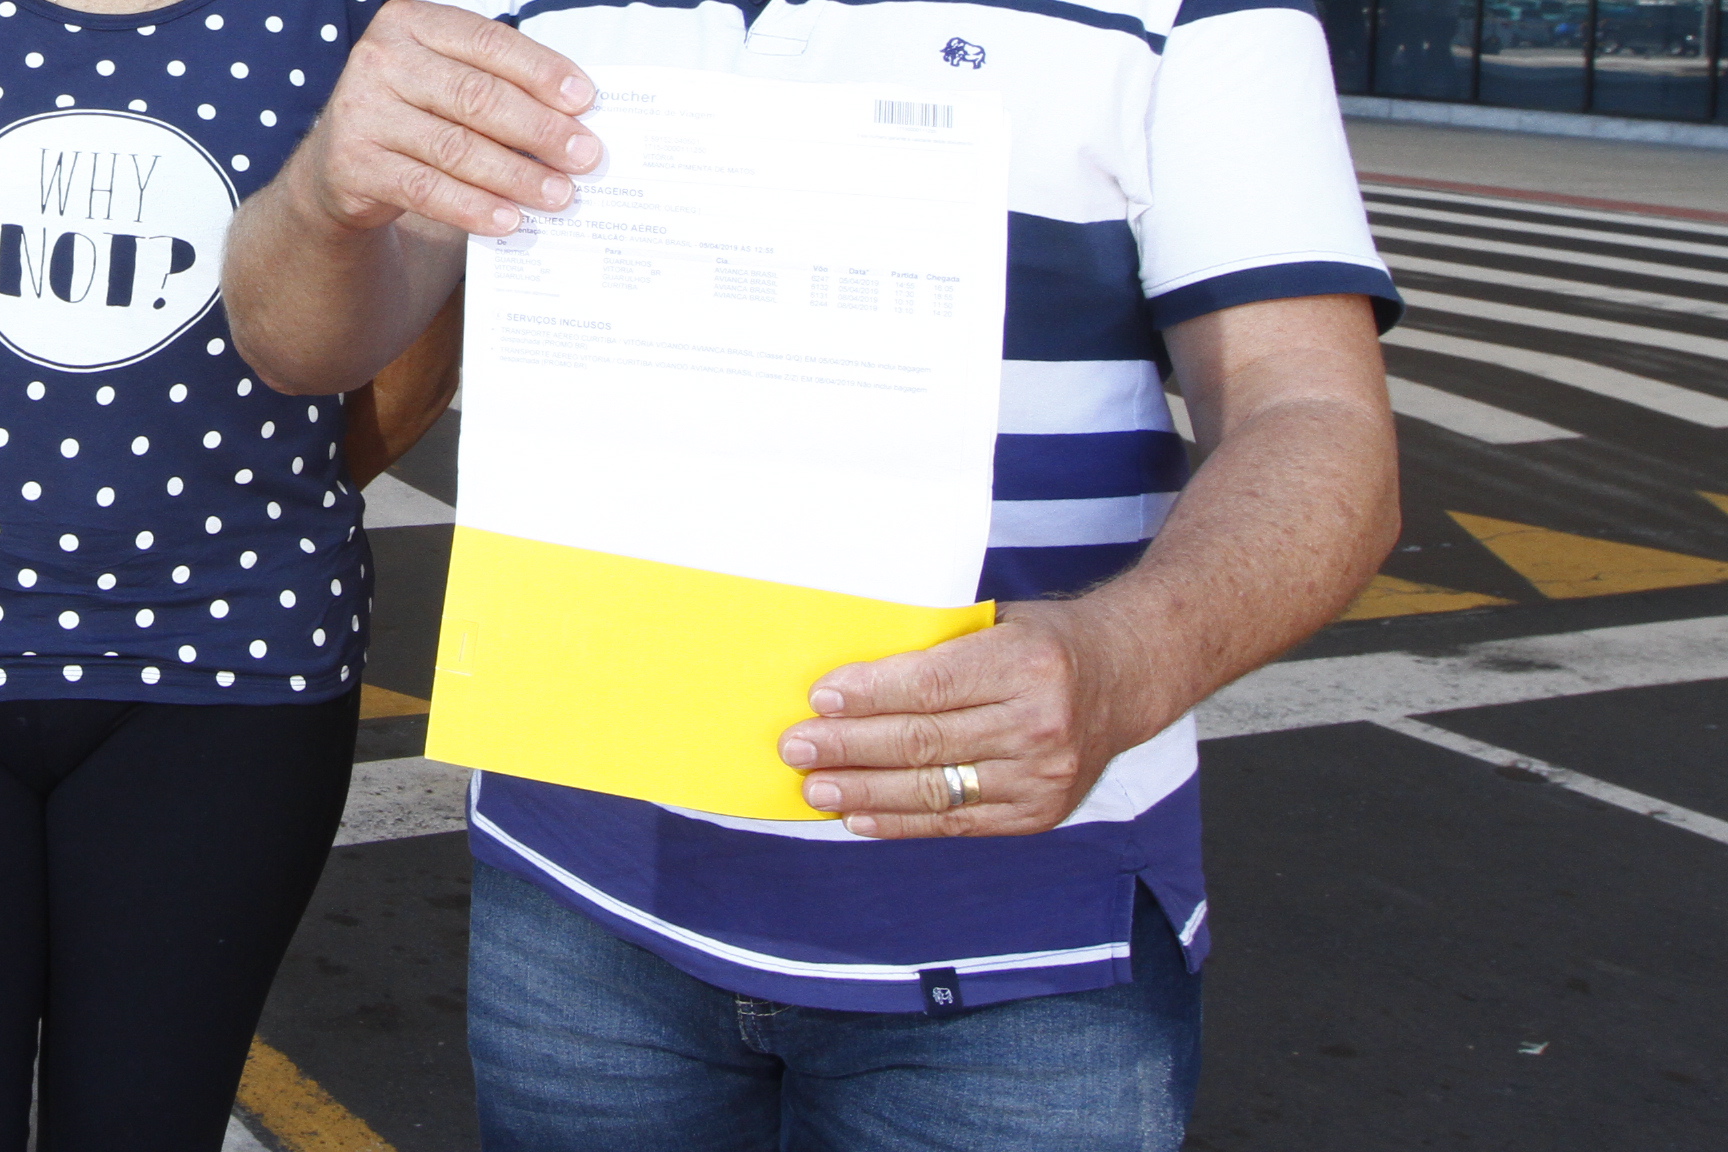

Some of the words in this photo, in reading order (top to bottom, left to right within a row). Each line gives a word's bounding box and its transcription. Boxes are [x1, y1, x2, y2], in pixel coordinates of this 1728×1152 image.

[40, 148, 162, 222] WHY
[550, 230, 585, 238] CURITIBA
[629, 236, 664, 245] AVIANCA
[568, 220, 582, 228] DO
[586, 220, 628, 231] TRECHO
[632, 222, 667, 234] AÉREO
[494, 256, 542, 266] GUARULHOS
[714, 276, 748, 284] AVIANCA
[603, 257, 652, 268] GUARULHOS
[714, 267, 748, 276] AVIANCA
[604, 248, 622, 256] Para
[890, 270, 918, 280] Partida
[926, 274, 960, 283] Chegada
[494, 272, 542, 282] GUARULHOS
[713, 292, 747, 300] AVIANCA
[602, 274, 652, 284] GUARULHOS
[714, 284, 748, 292] AVIANCA
[506, 312, 557, 326] SERVIÇOS
[560, 318, 612, 330] INCLUSOS
[501, 326, 550, 338] TRANSPORTE
[580, 334, 616, 344] CURITIBA
[656, 342, 690, 350] VOANDO
[692, 345, 725, 354] AVIANCA
[728, 348, 754, 358] BRASIL
[500, 346, 550, 357] TRANSPORTE
[656, 362, 688, 370] VOANDO
[690, 364, 724, 374] AVIANCA
